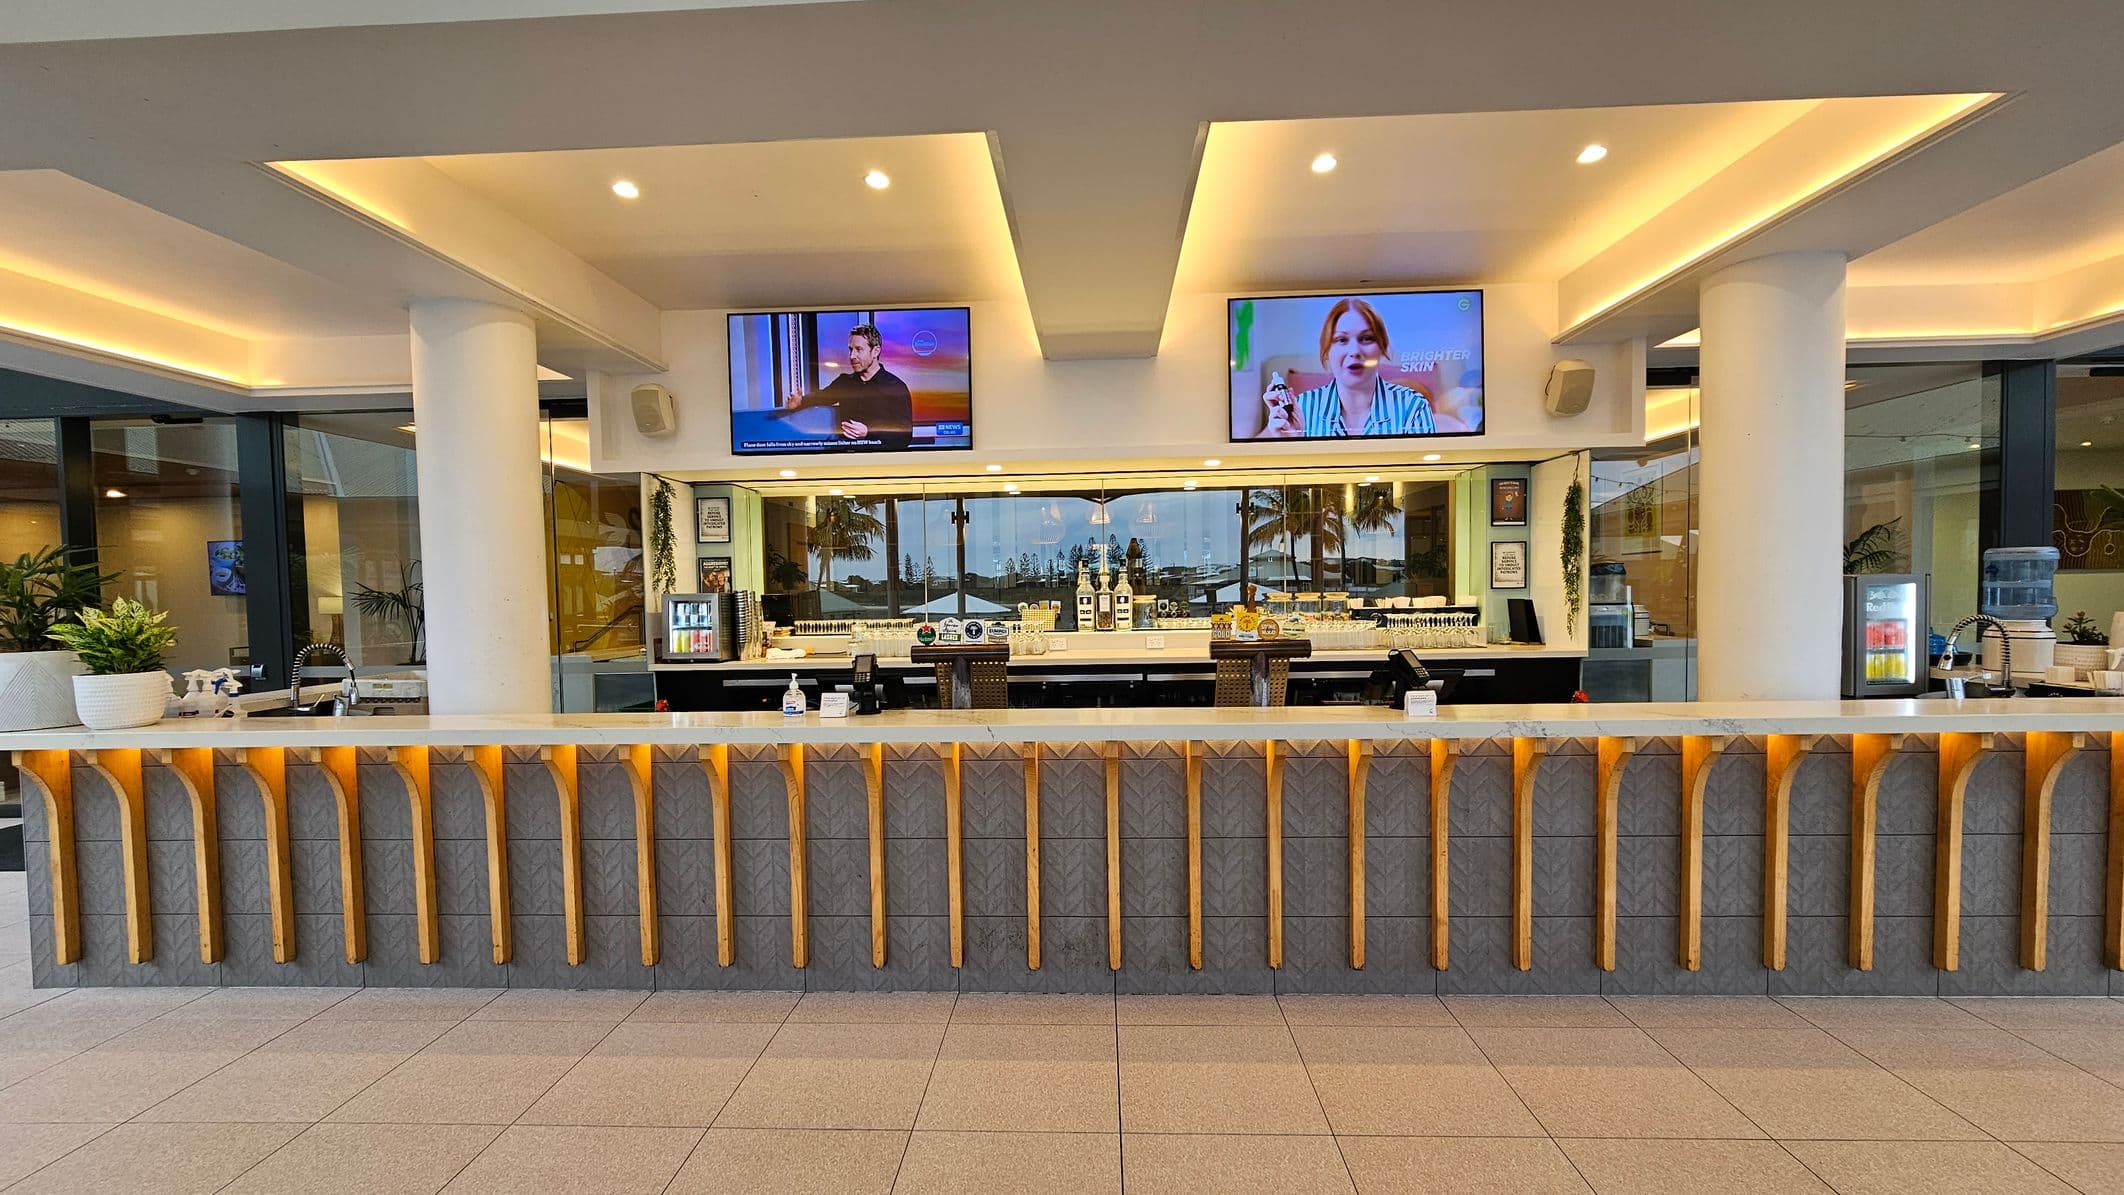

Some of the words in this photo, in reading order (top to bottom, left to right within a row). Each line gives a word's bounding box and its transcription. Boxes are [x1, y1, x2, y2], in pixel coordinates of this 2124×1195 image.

[1400, 350, 1471, 361] BRIGHTER
[1400, 360, 1434, 373] SKIN
[1210, 622, 1233, 630] XXXX
[1212, 630, 1231, 639] GOLD
